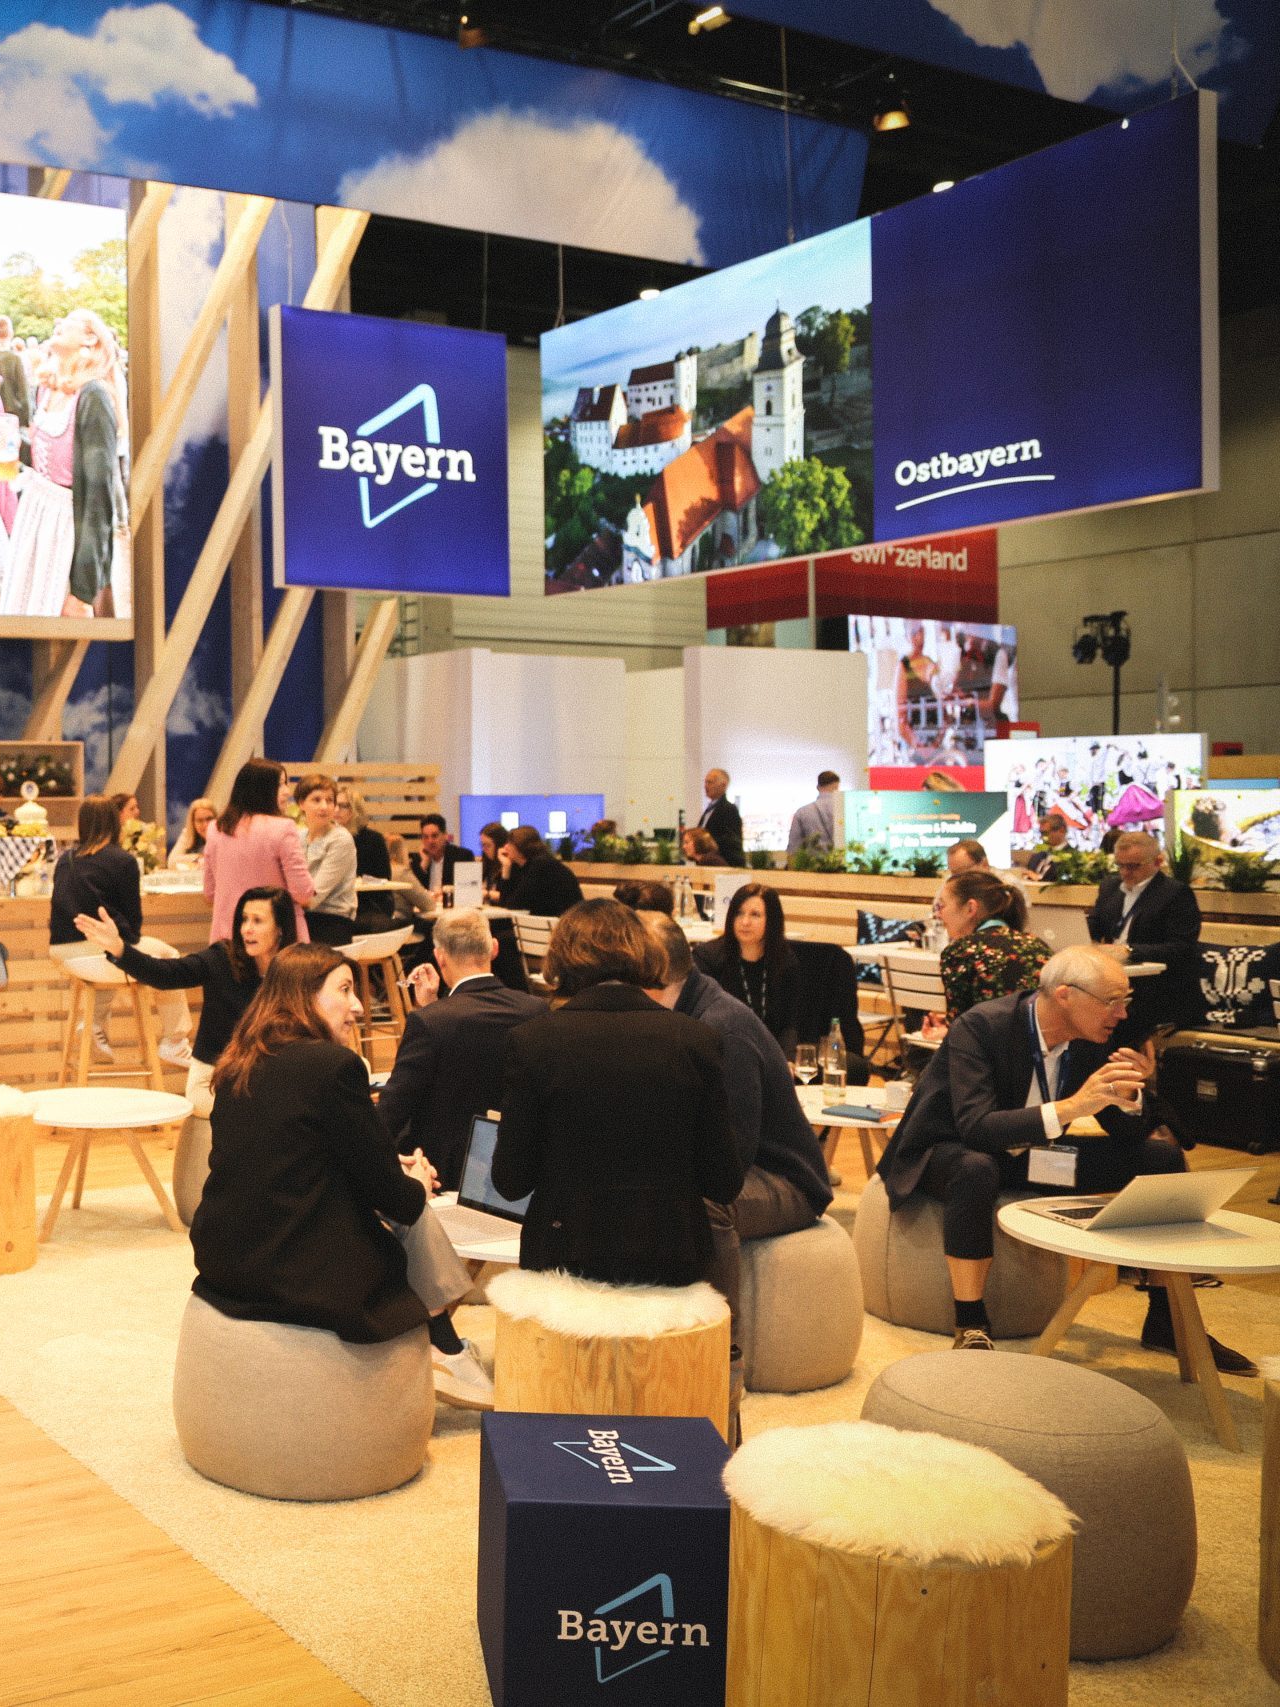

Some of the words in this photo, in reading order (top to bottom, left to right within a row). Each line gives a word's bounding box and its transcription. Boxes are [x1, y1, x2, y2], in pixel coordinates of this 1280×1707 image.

[318, 425, 477, 485] Bayern
[894, 438, 1042, 486] Ostbayern
[587, 1429, 634, 1484] Bayern
[557, 1609, 710, 1651] Bayern
